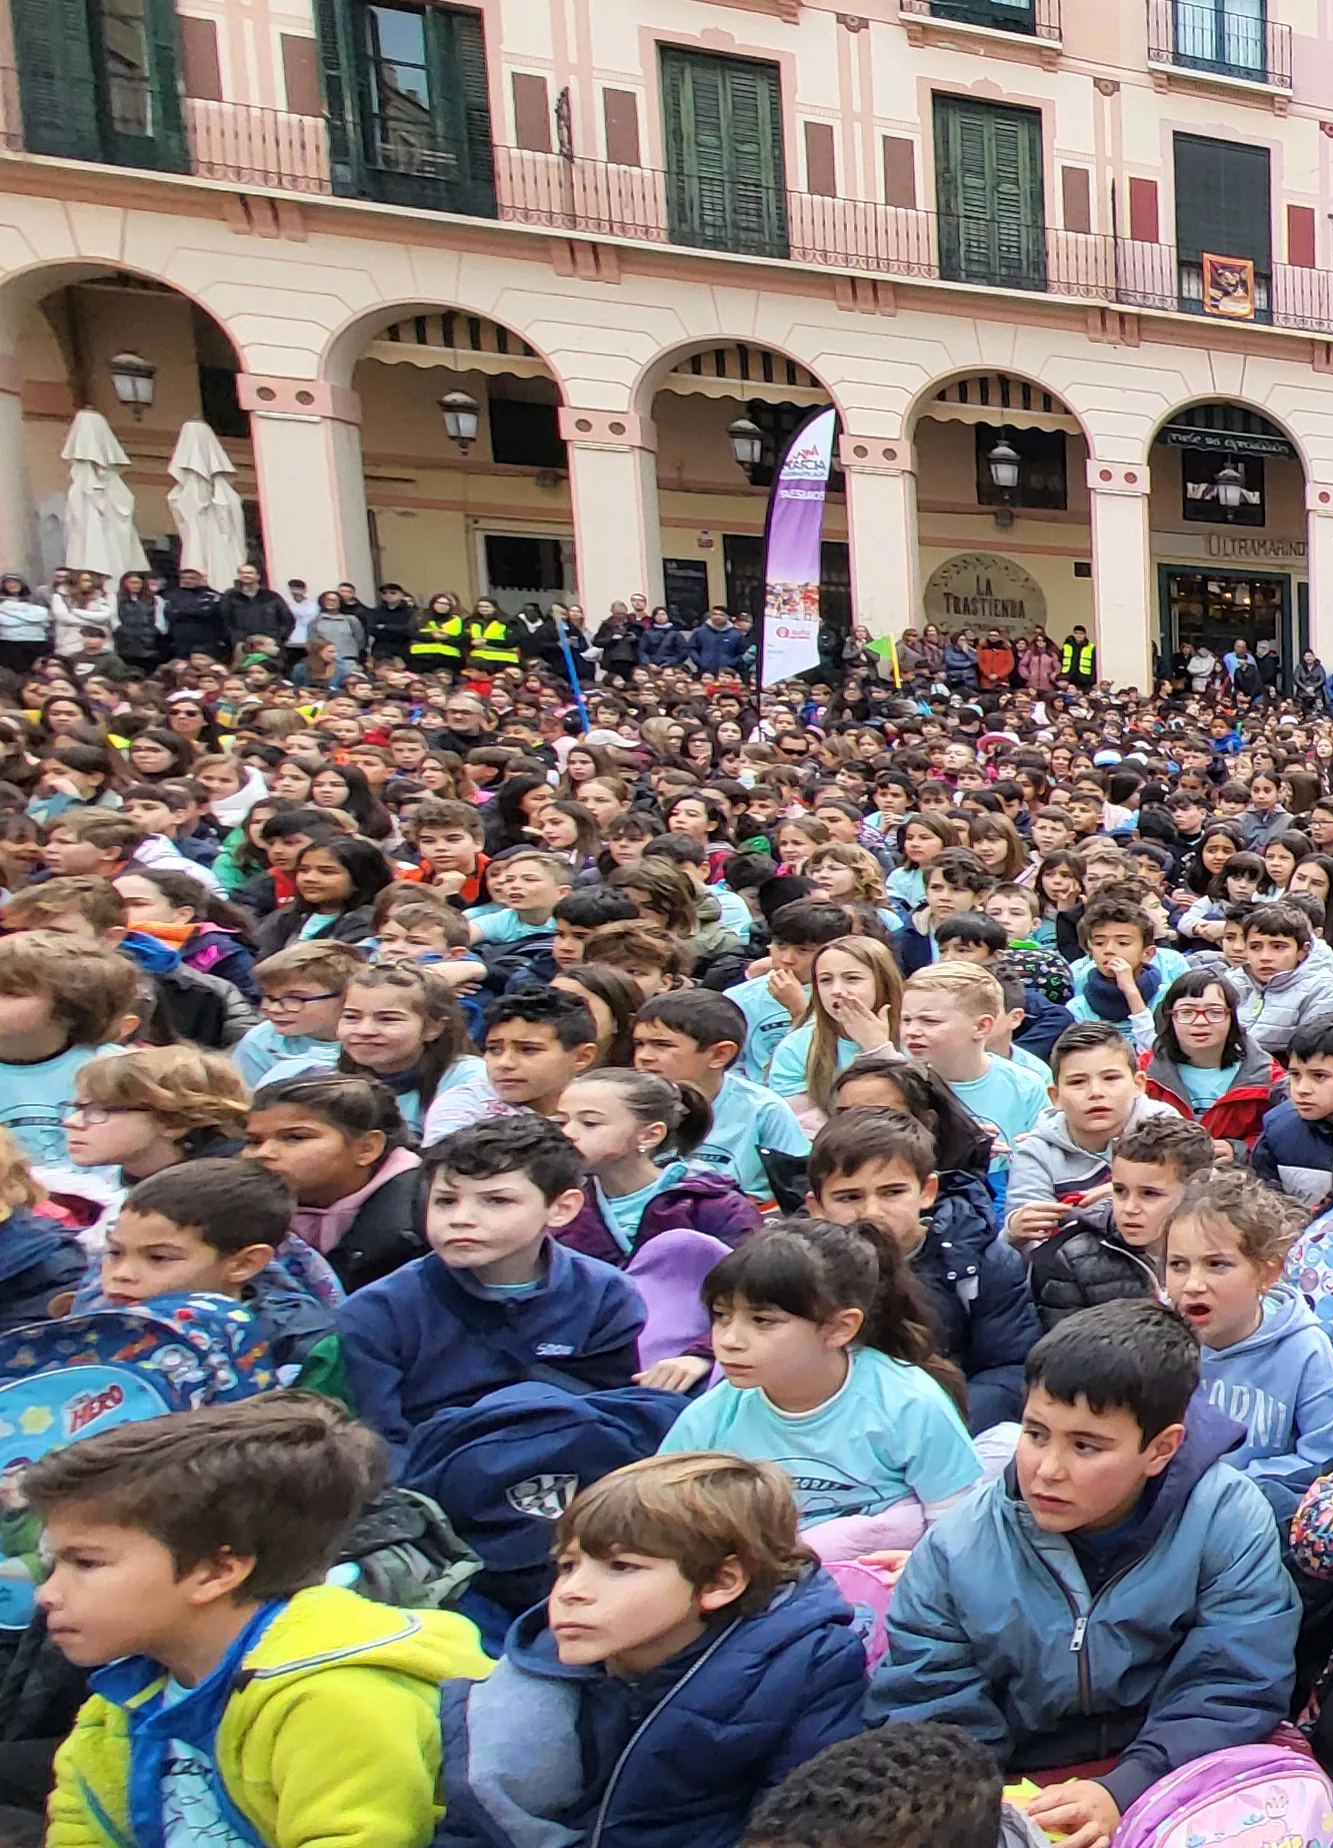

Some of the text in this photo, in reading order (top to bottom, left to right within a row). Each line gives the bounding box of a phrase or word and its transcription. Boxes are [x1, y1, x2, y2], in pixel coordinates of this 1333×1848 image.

[975, 575, 993, 597] LA
[943, 592, 1026, 619] TRASTIENDA
[70, 1384, 125, 1434] HERO
